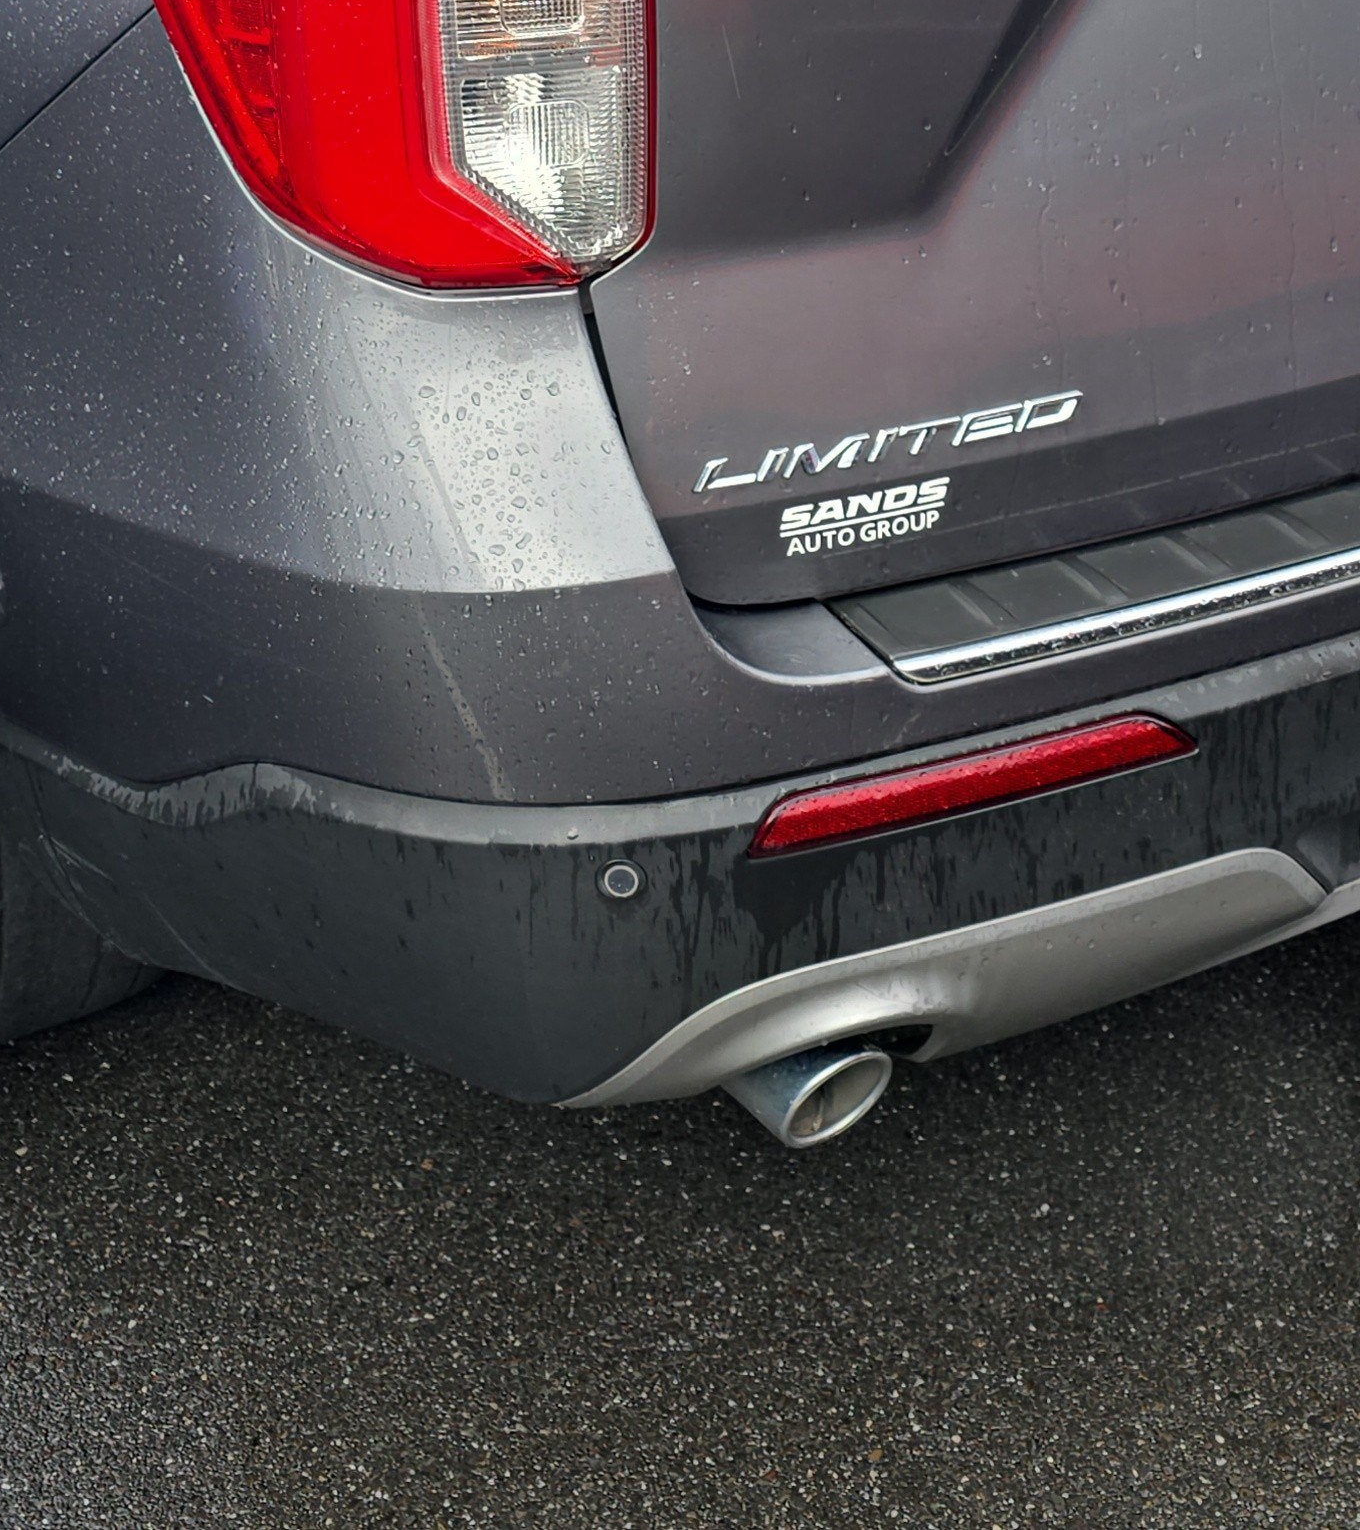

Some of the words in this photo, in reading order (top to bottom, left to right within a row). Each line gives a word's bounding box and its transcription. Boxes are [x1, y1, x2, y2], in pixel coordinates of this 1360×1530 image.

[692, 389, 1084, 493] LIMITED
[779, 476, 951, 531] SANDS
[786, 527, 856, 557] AUTO
[860, 511, 940, 542] GROUP
